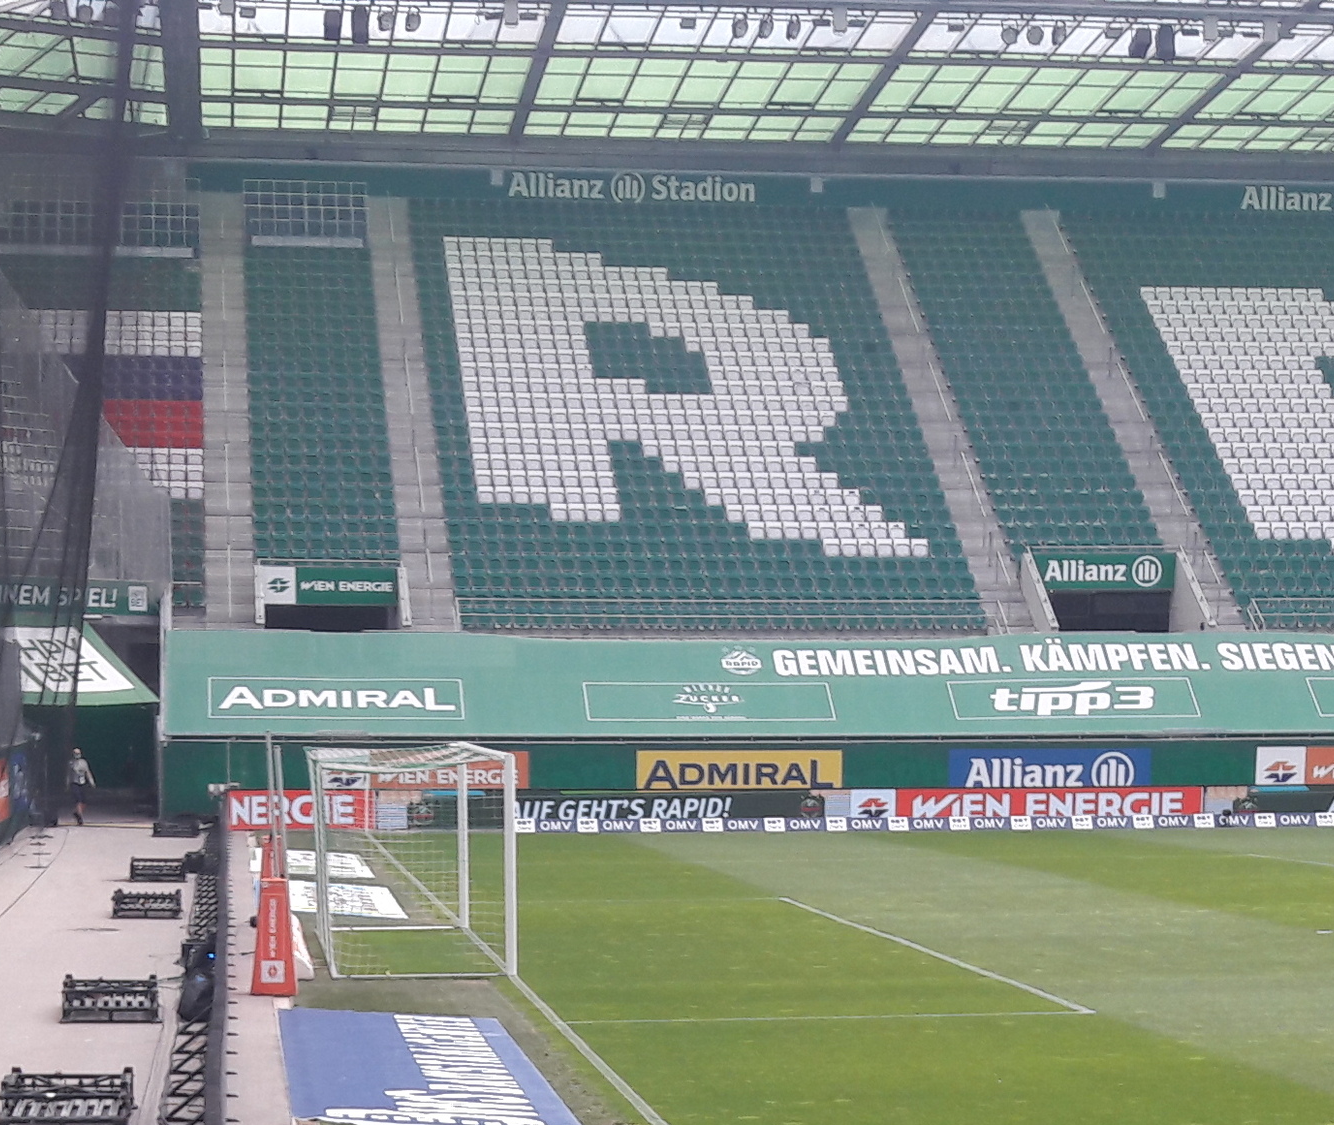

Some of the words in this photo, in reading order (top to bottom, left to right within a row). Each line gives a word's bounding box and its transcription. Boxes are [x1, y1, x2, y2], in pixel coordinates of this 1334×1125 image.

[508, 172, 604, 199] Allianz
[651, 175, 755, 202] Stadion
[1241, 185, 1332, 212] Allianz
[1044, 559, 1127, 583] Allianz
[300, 580, 335, 591] WIEN
[338, 581, 394, 592] ENERGIE
[772, 645, 1011, 676] GEMEINSAM.
[1018, 638, 1210, 672] KÄMPFEN.
[218, 685, 456, 712] ADMIRAL
[989, 681, 1154, 716] tipp3
[644, 758, 833, 788] ADMIRAL
[963, 757, 1083, 788] Allianz
[558, 797, 645, 820] GEHT'S
[650, 796, 732, 818] RAPID!
[912, 793, 1010, 818] WIEN
[1026, 791, 1184, 817] ENERGIE
[540, 821, 572, 831] OMV
[603, 821, 634, 831] OMV
[666, 821, 696, 830] OMV
[728, 820, 758, 830] OMV
[790, 819, 821, 829] OMV
[851, 819, 882, 829] OMV
[913, 819, 944, 829] OMV
[974, 818, 1005, 828] OMV
[1036, 818, 1066, 828] OMV
[1097, 818, 1127, 827] OMV
[1158, 816, 1189, 826] OMV
[1280, 815, 1310, 825] OMV
